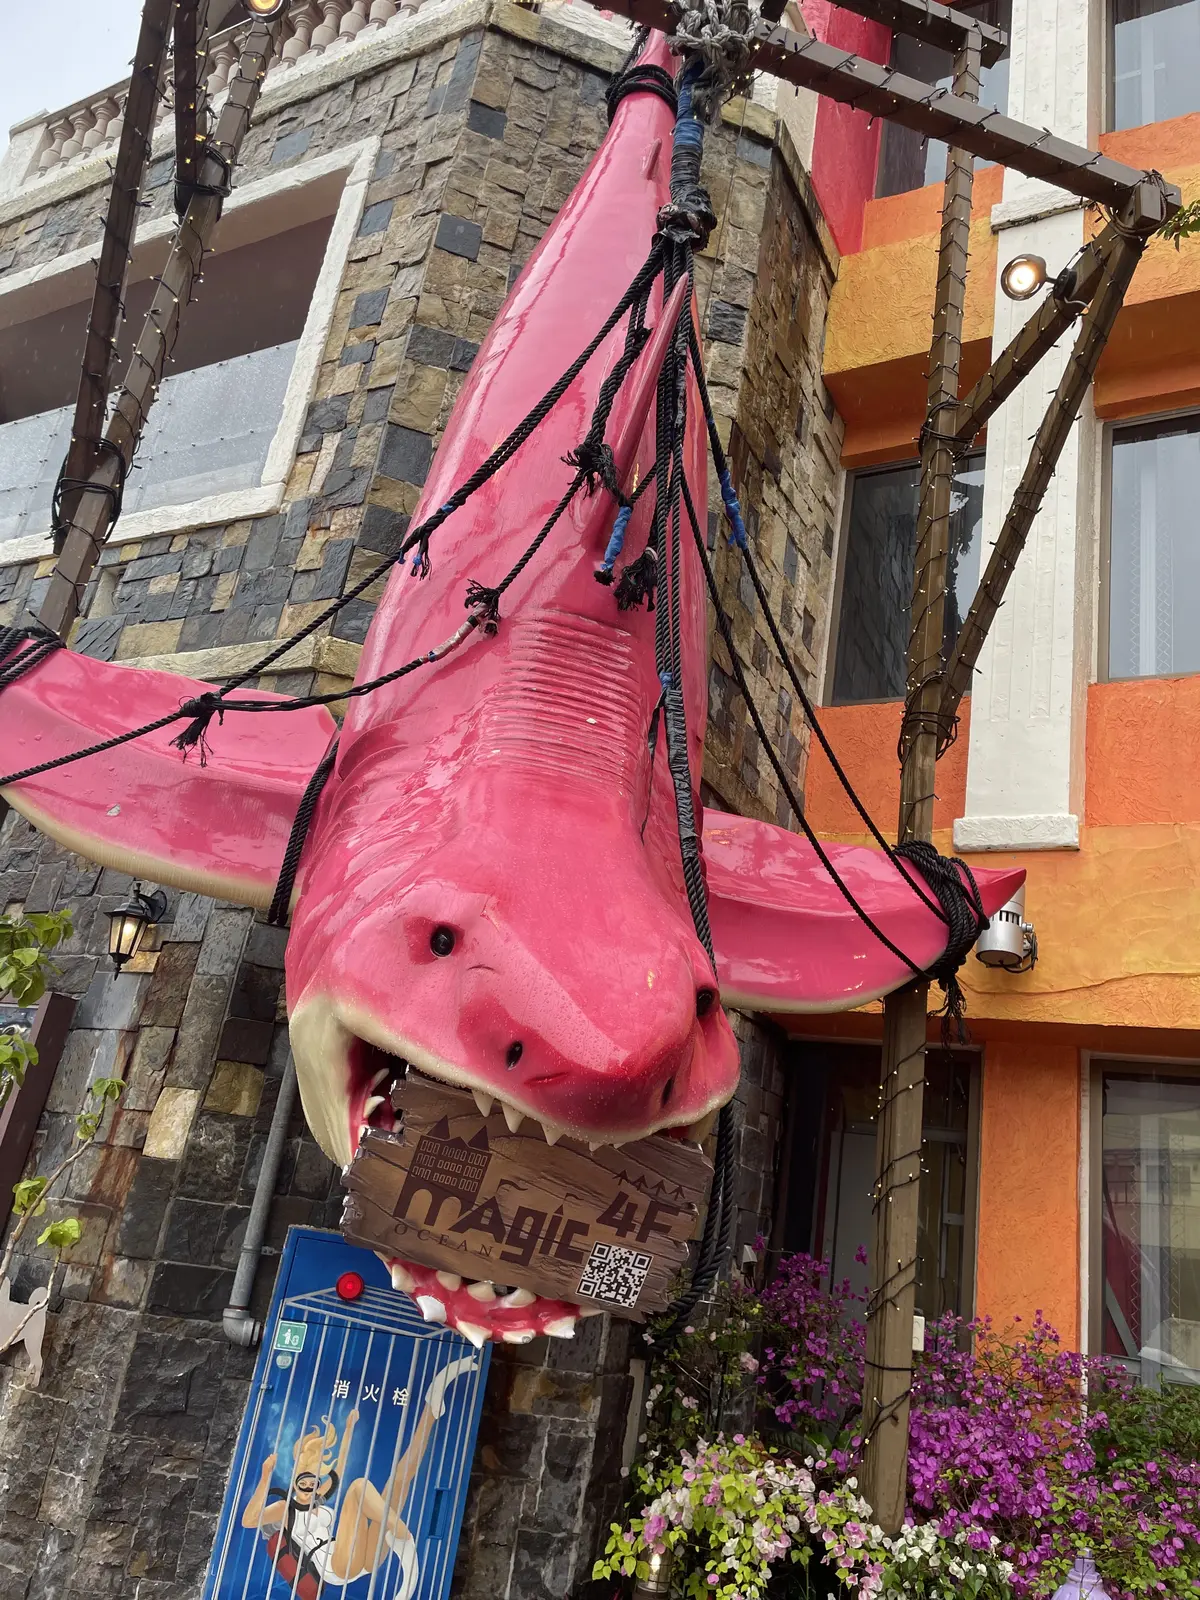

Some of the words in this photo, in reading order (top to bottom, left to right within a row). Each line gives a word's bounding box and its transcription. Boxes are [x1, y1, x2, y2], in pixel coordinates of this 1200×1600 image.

[596, 1191, 683, 1244] 4F
[394, 1223, 494, 1257] OCEAN
[331, 1379, 410, 1406] 消火栓
